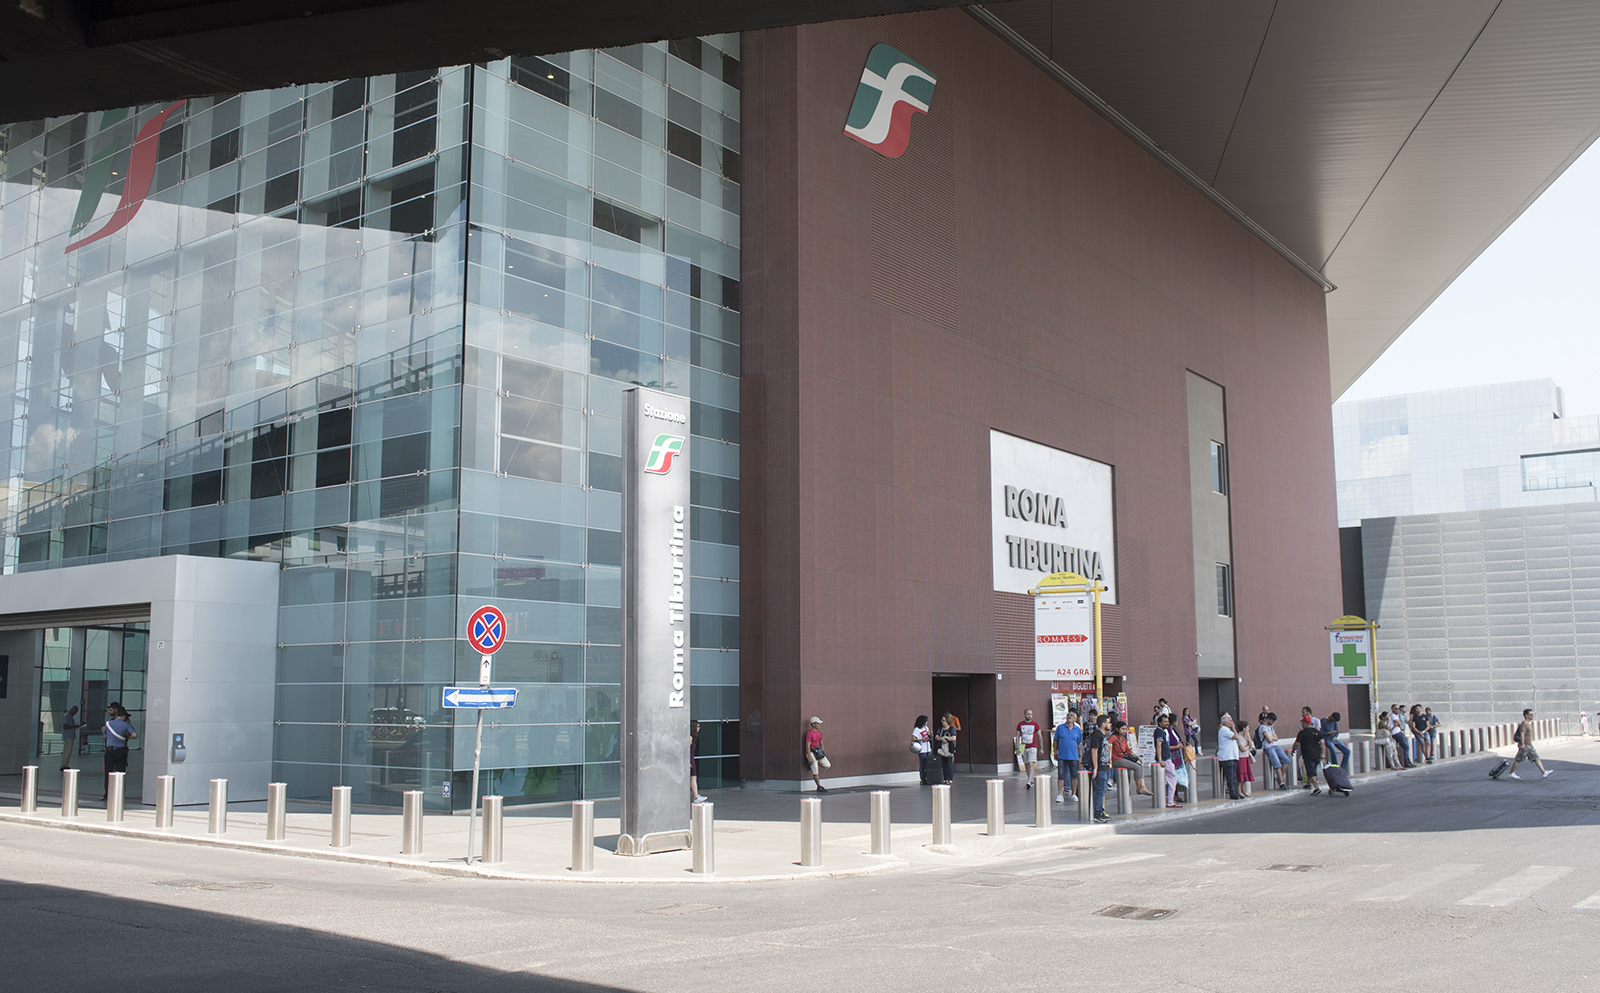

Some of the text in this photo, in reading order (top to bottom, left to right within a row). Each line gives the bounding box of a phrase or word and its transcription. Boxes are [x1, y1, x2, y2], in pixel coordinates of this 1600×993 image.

[643, 402, 686, 424] Stazione
[1004, 484, 1068, 528] ROMA
[1005, 535, 1105, 581] TIBURTINA
[668, 505, 685, 709] Roma Tiburtina
[1057, 668, 1071, 676] A24
[1073, 668, 1090, 676] GRA
